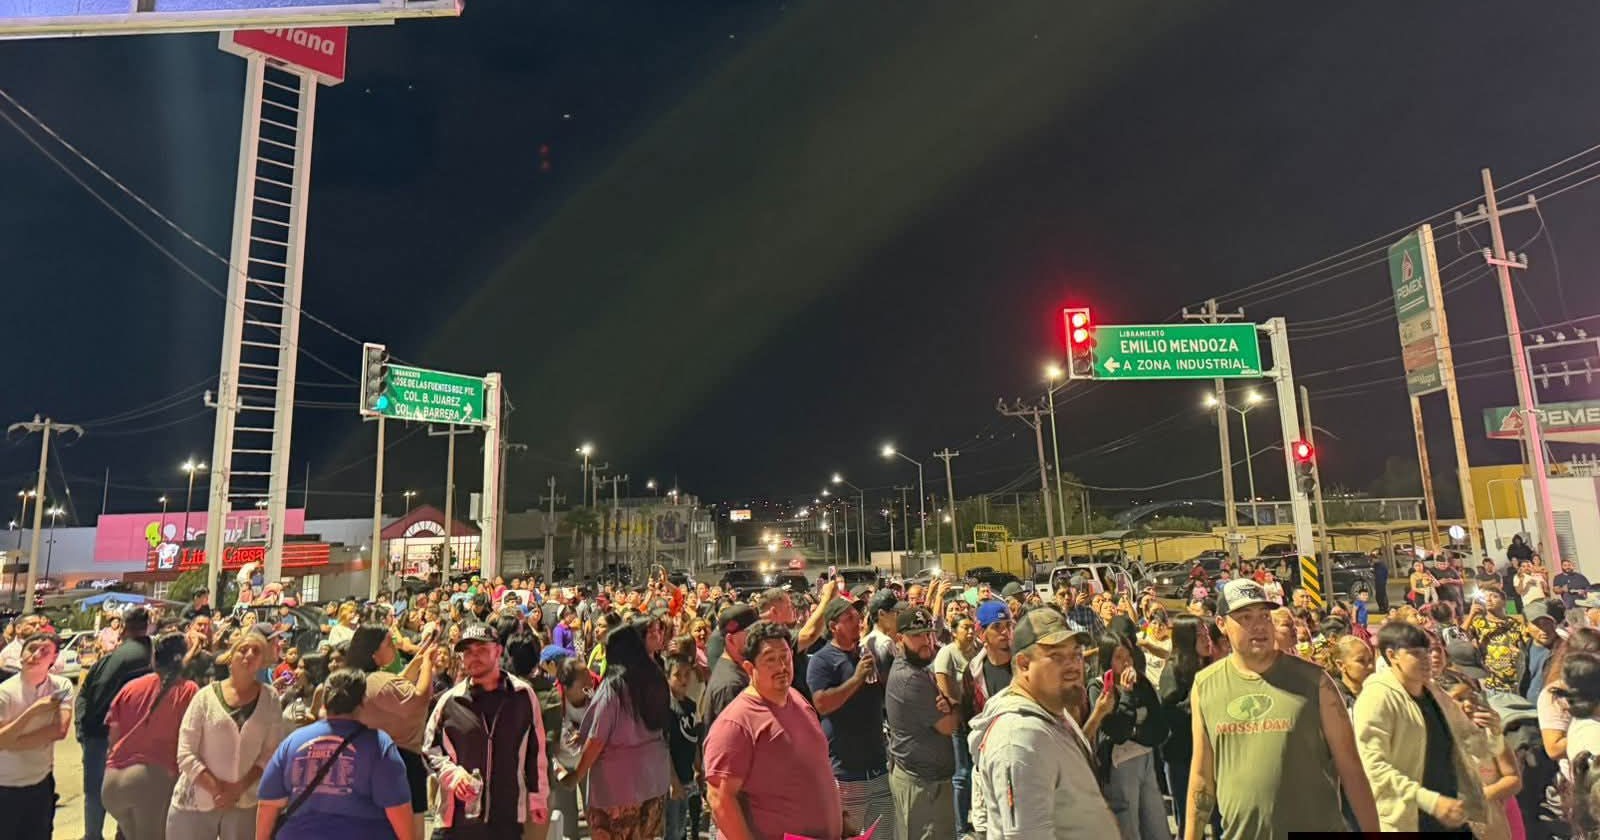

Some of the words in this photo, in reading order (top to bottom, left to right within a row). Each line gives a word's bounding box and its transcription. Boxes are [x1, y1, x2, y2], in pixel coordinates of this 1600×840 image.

[263, 27, 335, 56] riana
[1119, 330, 1165, 338] LIBRAMIENTO
[1120, 340, 1168, 354] EMILIO
[1170, 338, 1239, 353] MENDOZA
[1123, 360, 1132, 370] A
[1137, 359, 1171, 370] ZONA
[1176, 358, 1249, 370] INDUSTRIAL
[391, 376, 407, 388] JOSE
[431, 394, 460, 407] JUAREZ
[424, 406, 460, 420] BARRERA
[223, 546, 264, 564] Caesa
